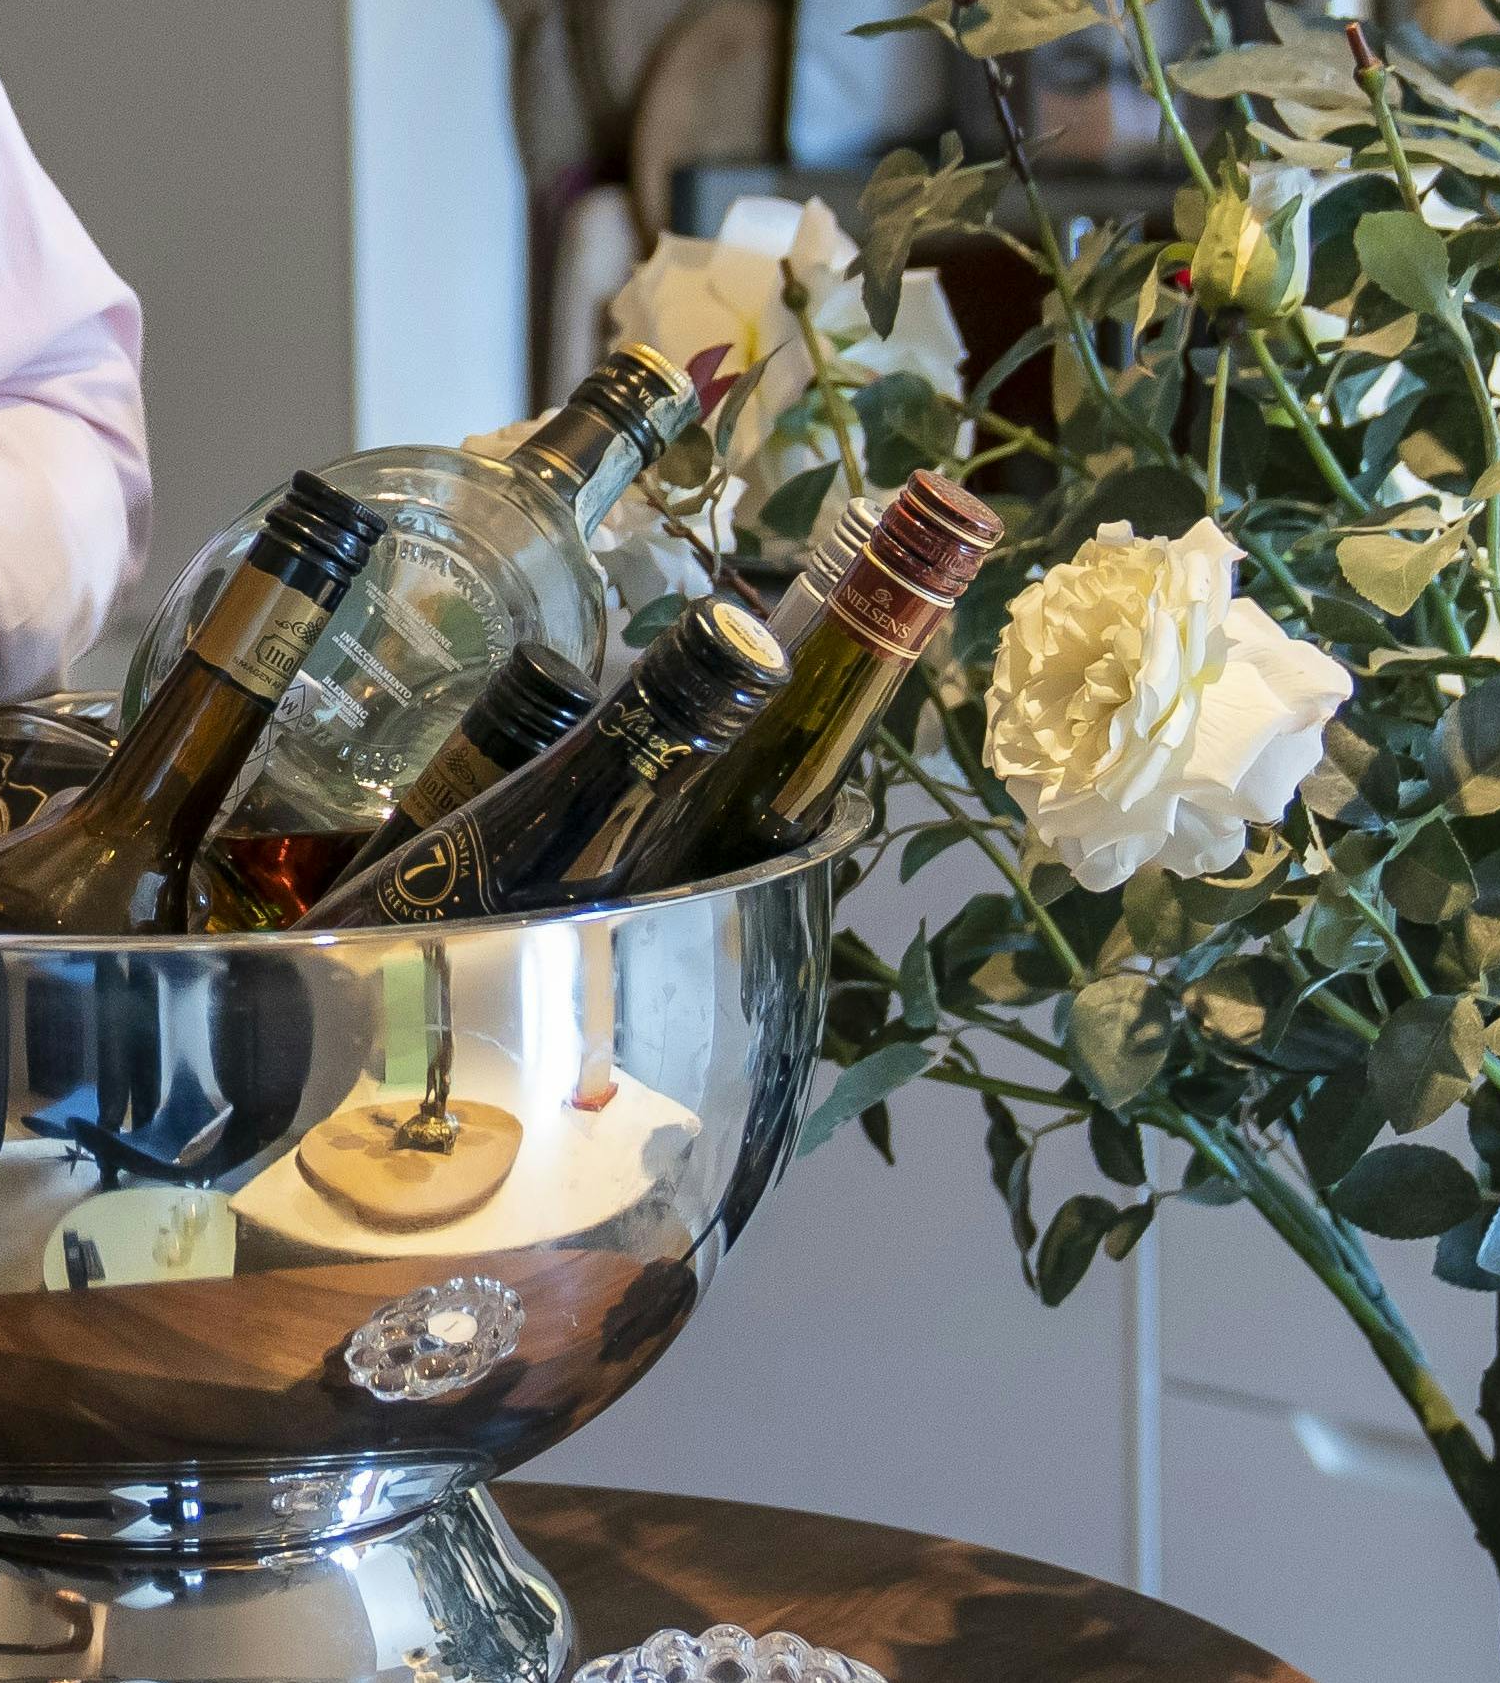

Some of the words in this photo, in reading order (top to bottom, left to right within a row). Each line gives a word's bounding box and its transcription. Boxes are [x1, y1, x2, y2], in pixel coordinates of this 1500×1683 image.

[842, 584, 912, 639] NIELSEN'S
[339, 631, 413, 700] INVECCHIAMENTO
[321, 675, 369, 720] BLENDING
[403, 843, 447, 881] 7
